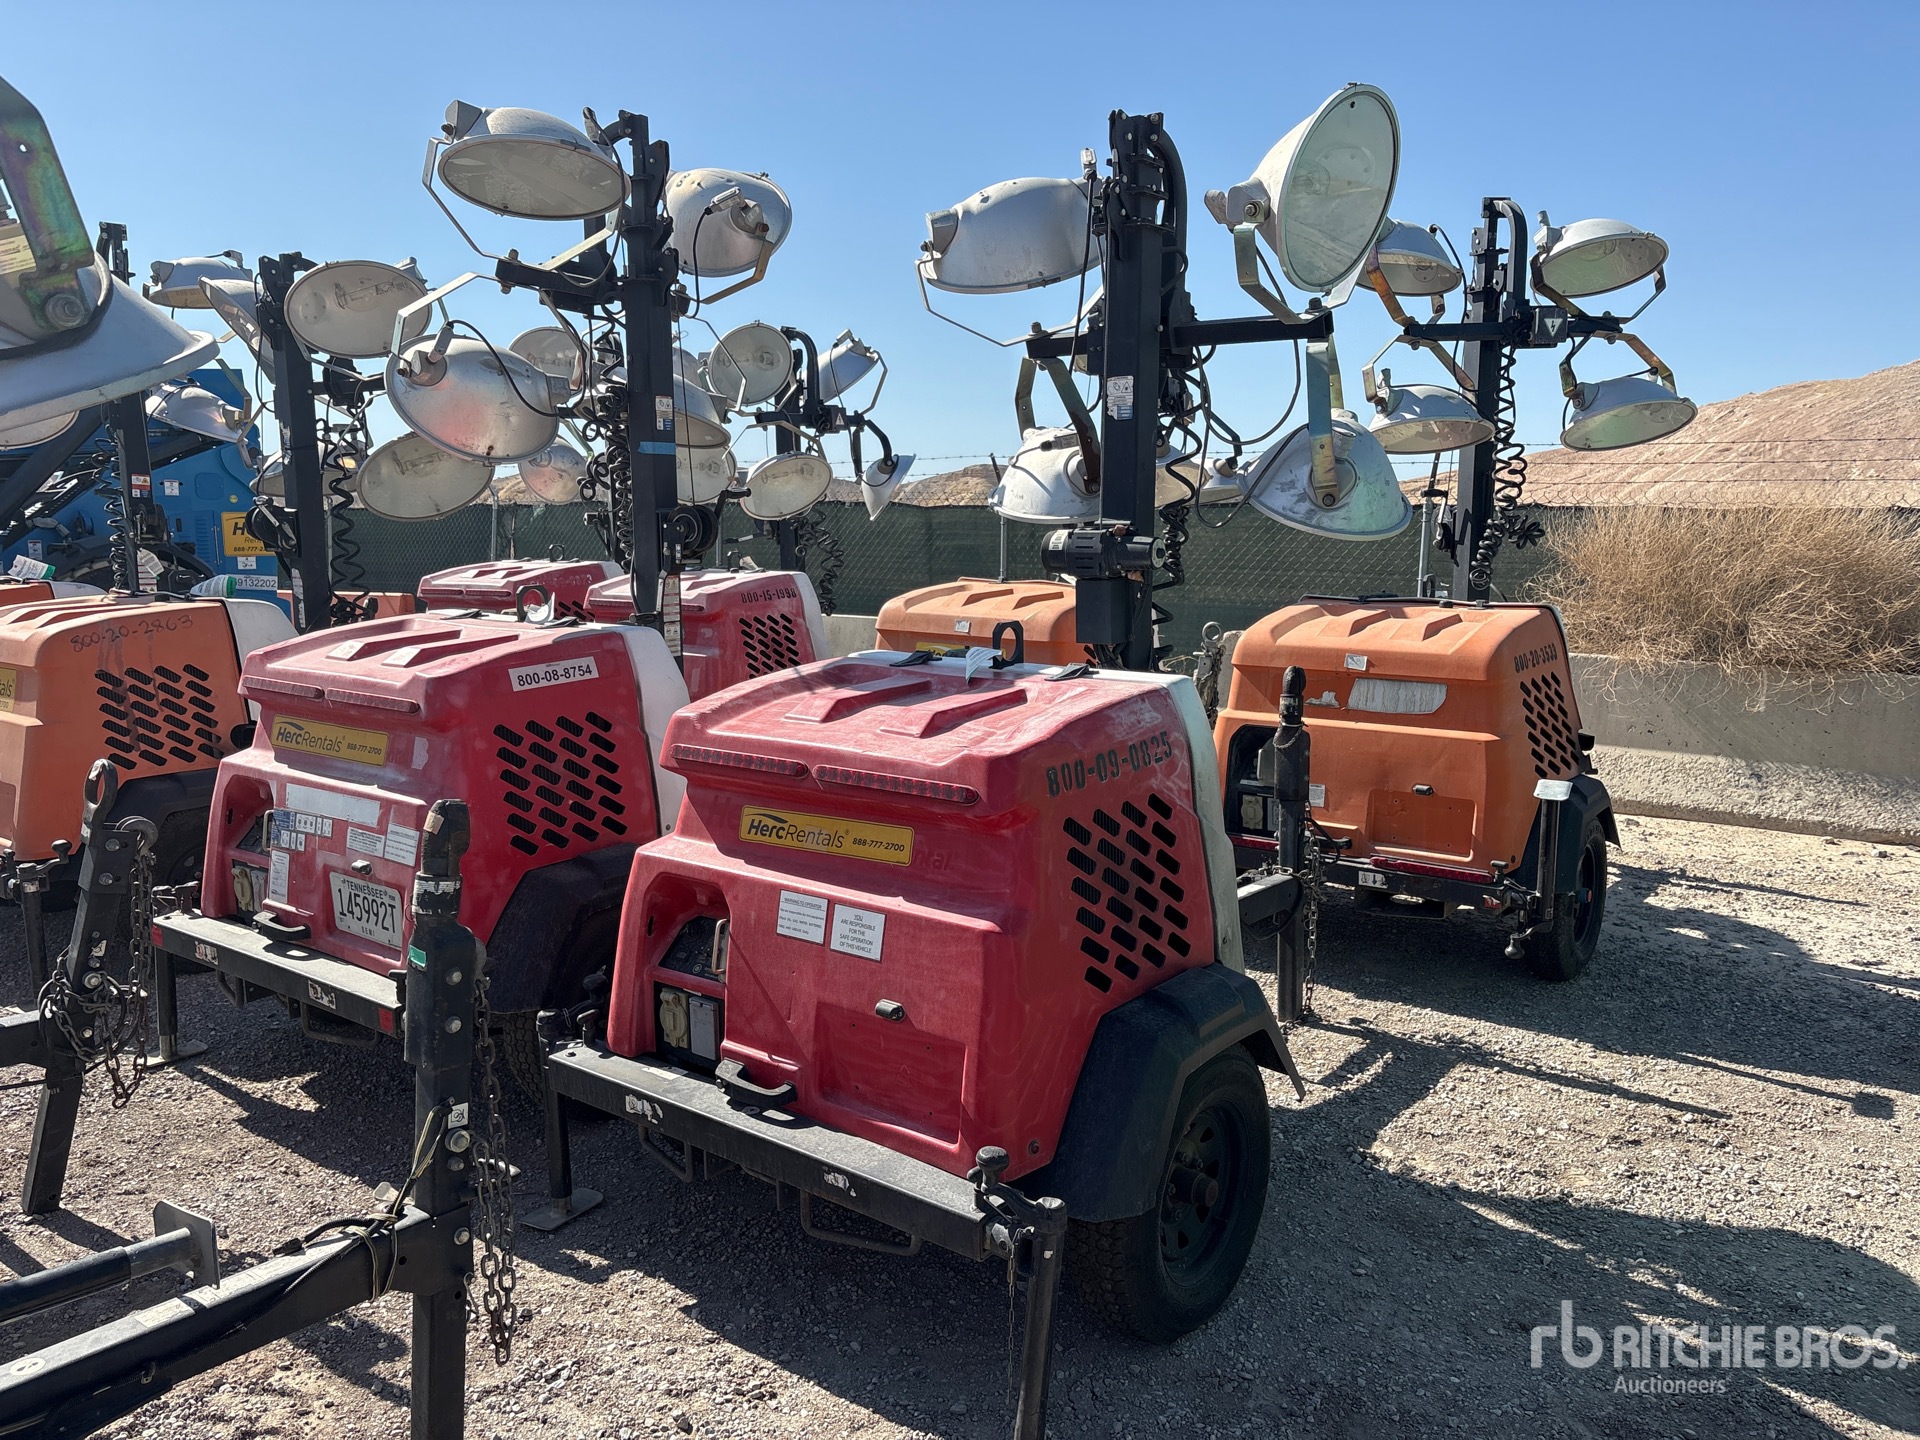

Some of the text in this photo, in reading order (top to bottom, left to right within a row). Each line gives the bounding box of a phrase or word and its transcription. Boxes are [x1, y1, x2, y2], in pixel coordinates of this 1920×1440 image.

[237, 578, 277, 588] 9132202
[741, 588, 796, 603] 800-15-1998
[517, 664, 592, 686] 800-08-8754
[346, 742, 382, 755] 888-777-2700
[1047, 731, 1172, 797] 800-09-0825
[852, 837, 905, 852] 888-777-2700
[347, 880, 384, 899] TENNESSEE
[338, 888, 396, 933] 145992T
[848, 920, 876, 931] RESPONSIBLE
[850, 936, 873, 946] OPERATION
[854, 944, 872, 953] VEHICLE
